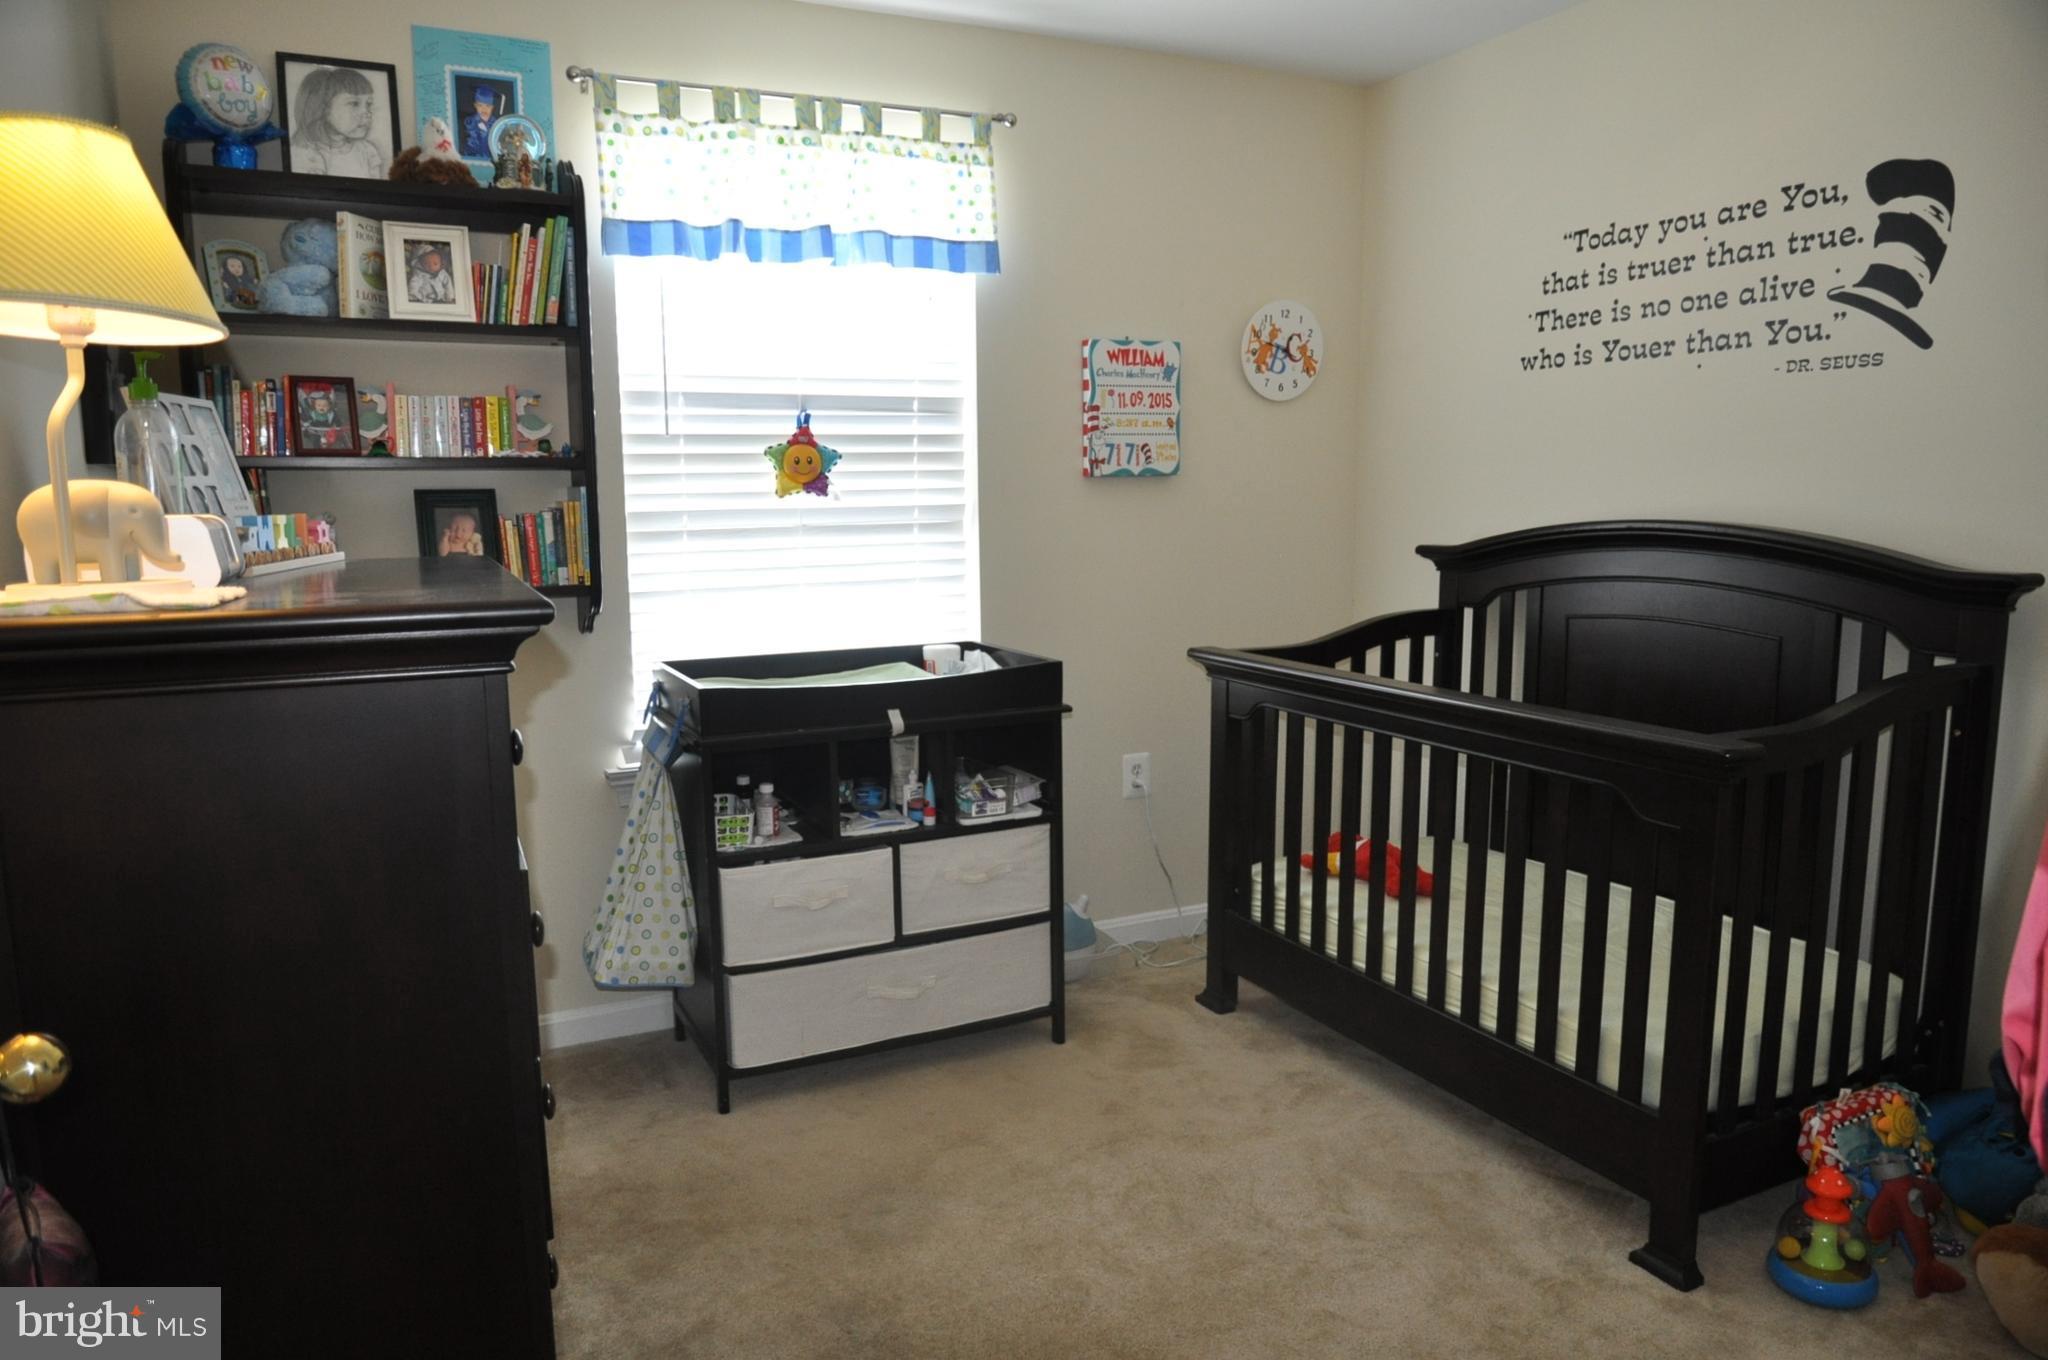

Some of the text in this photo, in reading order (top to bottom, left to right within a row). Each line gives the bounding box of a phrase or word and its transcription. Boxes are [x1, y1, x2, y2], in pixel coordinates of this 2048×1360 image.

[210, 54, 255, 74] new
[219, 92, 258, 125] boy
[1657, 211, 1707, 245] you
[1717, 198, 1768, 226] are
[1780, 183, 1849, 213] You,
[1541, 225, 1865, 296] that is truer than true.
[1534, 274, 1816, 333] There is no one alive
[1264, 314, 1273, 324] 11
[1280, 309, 1290, 319] 12
[1308, 328, 1313, 338] 2
[1106, 347, 1165, 367] WILLIAM
[1520, 347, 1566, 372] who
[1573, 342, 1593, 367] is
[1601, 338, 1677, 363] Youer
[1685, 328, 1753, 355] than
[1785, 358, 1814, 374] DR.
[1819, 351, 1885, 372] SEUSS
[1096, 367, 1124, 379] Charles
[1278, 383, 1284, 392] 6
[1293, 379, 1298, 389] 5
